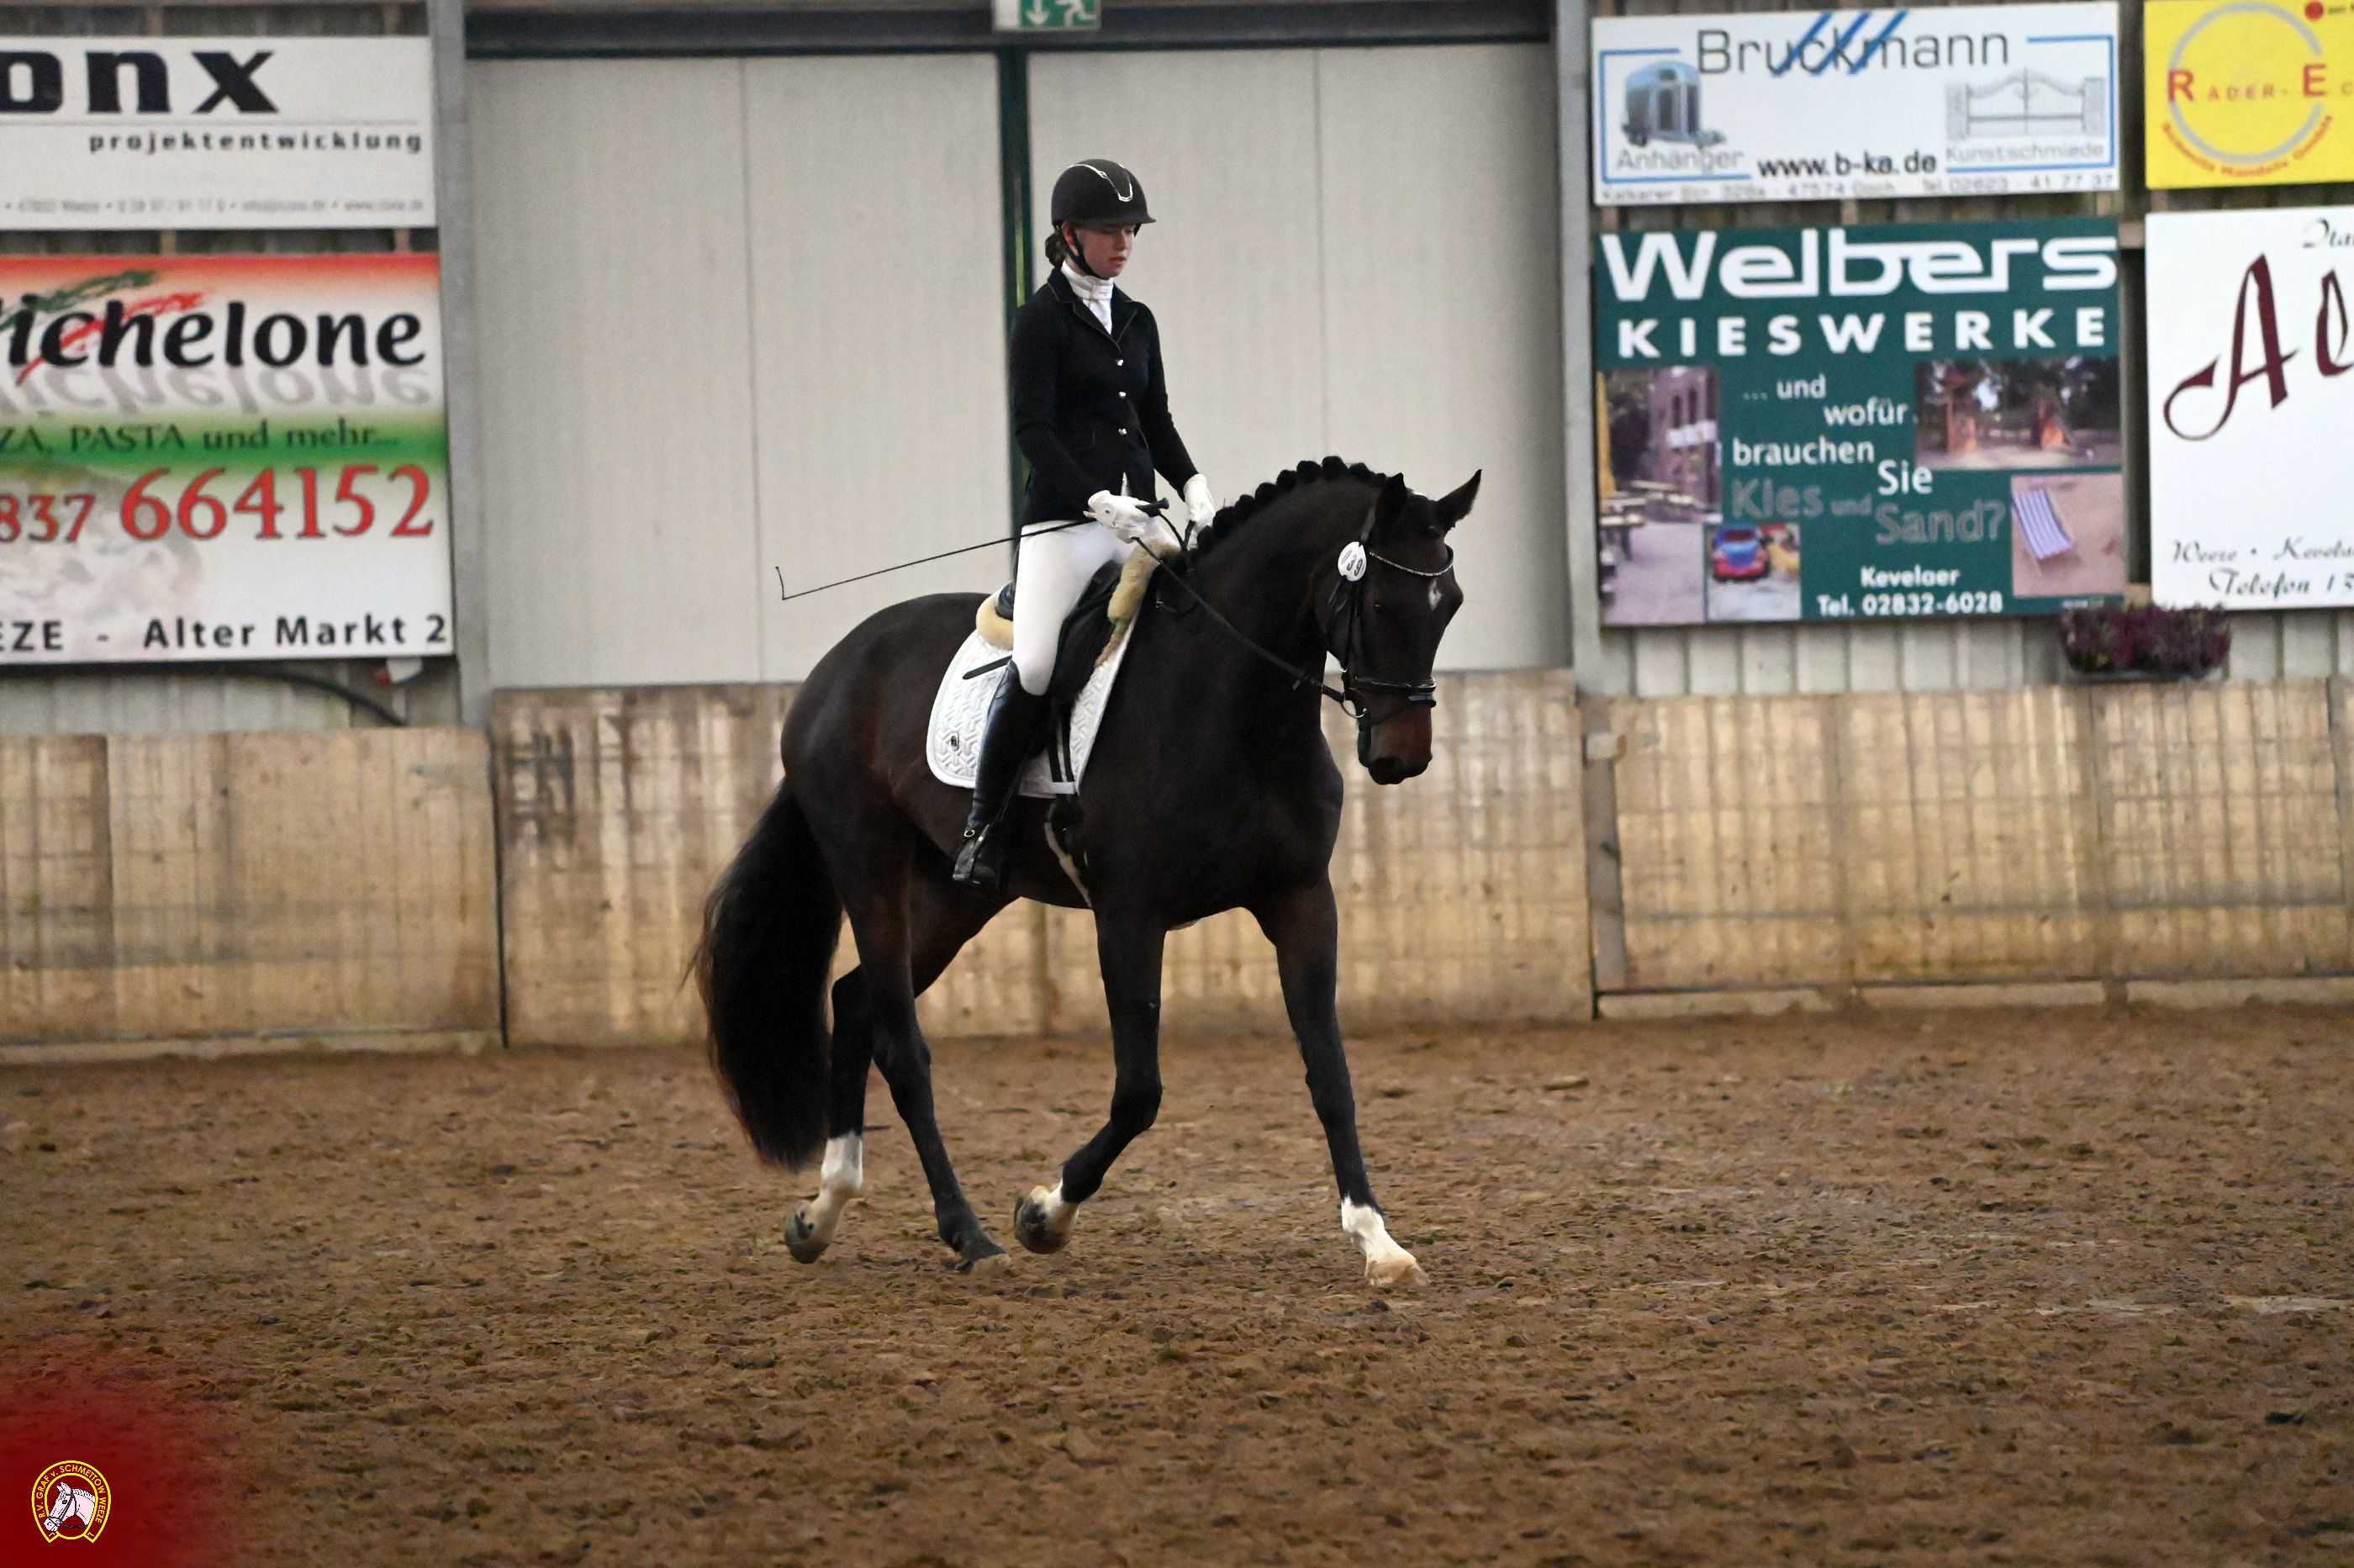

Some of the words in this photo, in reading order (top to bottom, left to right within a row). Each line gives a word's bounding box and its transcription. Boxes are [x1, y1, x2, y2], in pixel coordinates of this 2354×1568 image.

[0, 50, 279, 114] onx
[89, 129, 422, 152] projektentwicklung
[1758, 150, 1937, 177] www.b-ka.de
[1602, 229, 2117, 302] Welbers
[0, 293, 425, 367] ichelone
[1618, 308, 2105, 357] KIESWERKE
[1776, 372, 1826, 399] und
[1824, 396, 1908, 426] wofür
[70, 423, 185, 451] PASTA
[203, 417, 267, 449] und
[1733, 435, 1875, 466] brauchen
[1878, 460, 1933, 494] Sie
[120, 464, 433, 541] 664152
[1732, 478, 1824, 518] Kies
[1876, 499, 2006, 544] Sand?
[1860, 564, 1961, 587] Kevelaer
[2209, 568, 2310, 599] Telefon
[1816, 593, 1855, 617] Tel.
[1861, 591, 2003, 616] 02832-6028
[0, 620, 64, 651] ZE
[144, 617, 255, 648] Alter
[277, 614, 406, 647] Markt
[426, 614, 446, 644] 2
